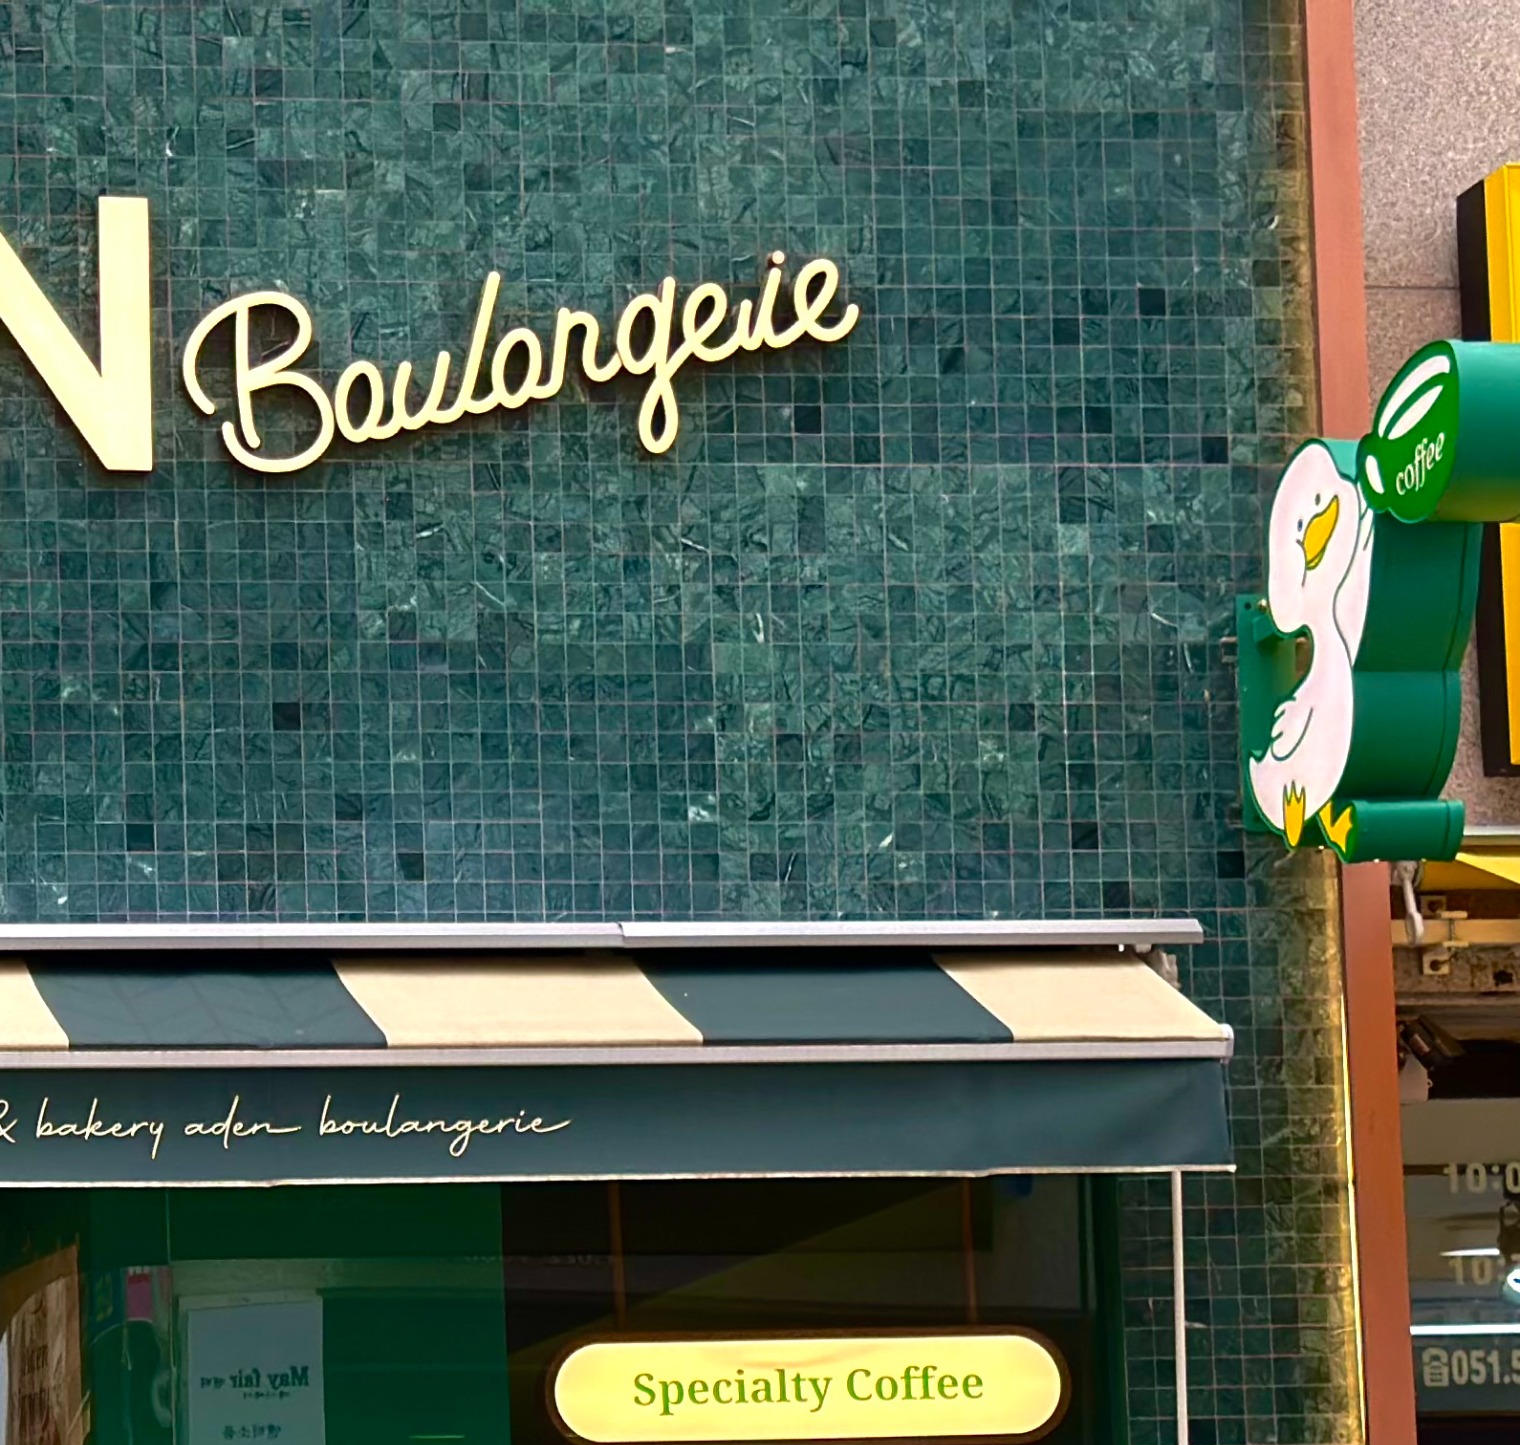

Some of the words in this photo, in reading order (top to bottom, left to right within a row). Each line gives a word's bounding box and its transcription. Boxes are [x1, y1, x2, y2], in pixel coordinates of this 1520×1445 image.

[183, 251, 859, 472] Boulangerie
[1395, 431, 1445, 496] coffee
[36, 1097, 166, 1158] bakery
[184, 1097, 301, 1135] aden
[319, 1095, 572, 1153] boulangerie
[633, 1368, 832, 1416] Specialty
[846, 1365, 984, 1401] Coffee
